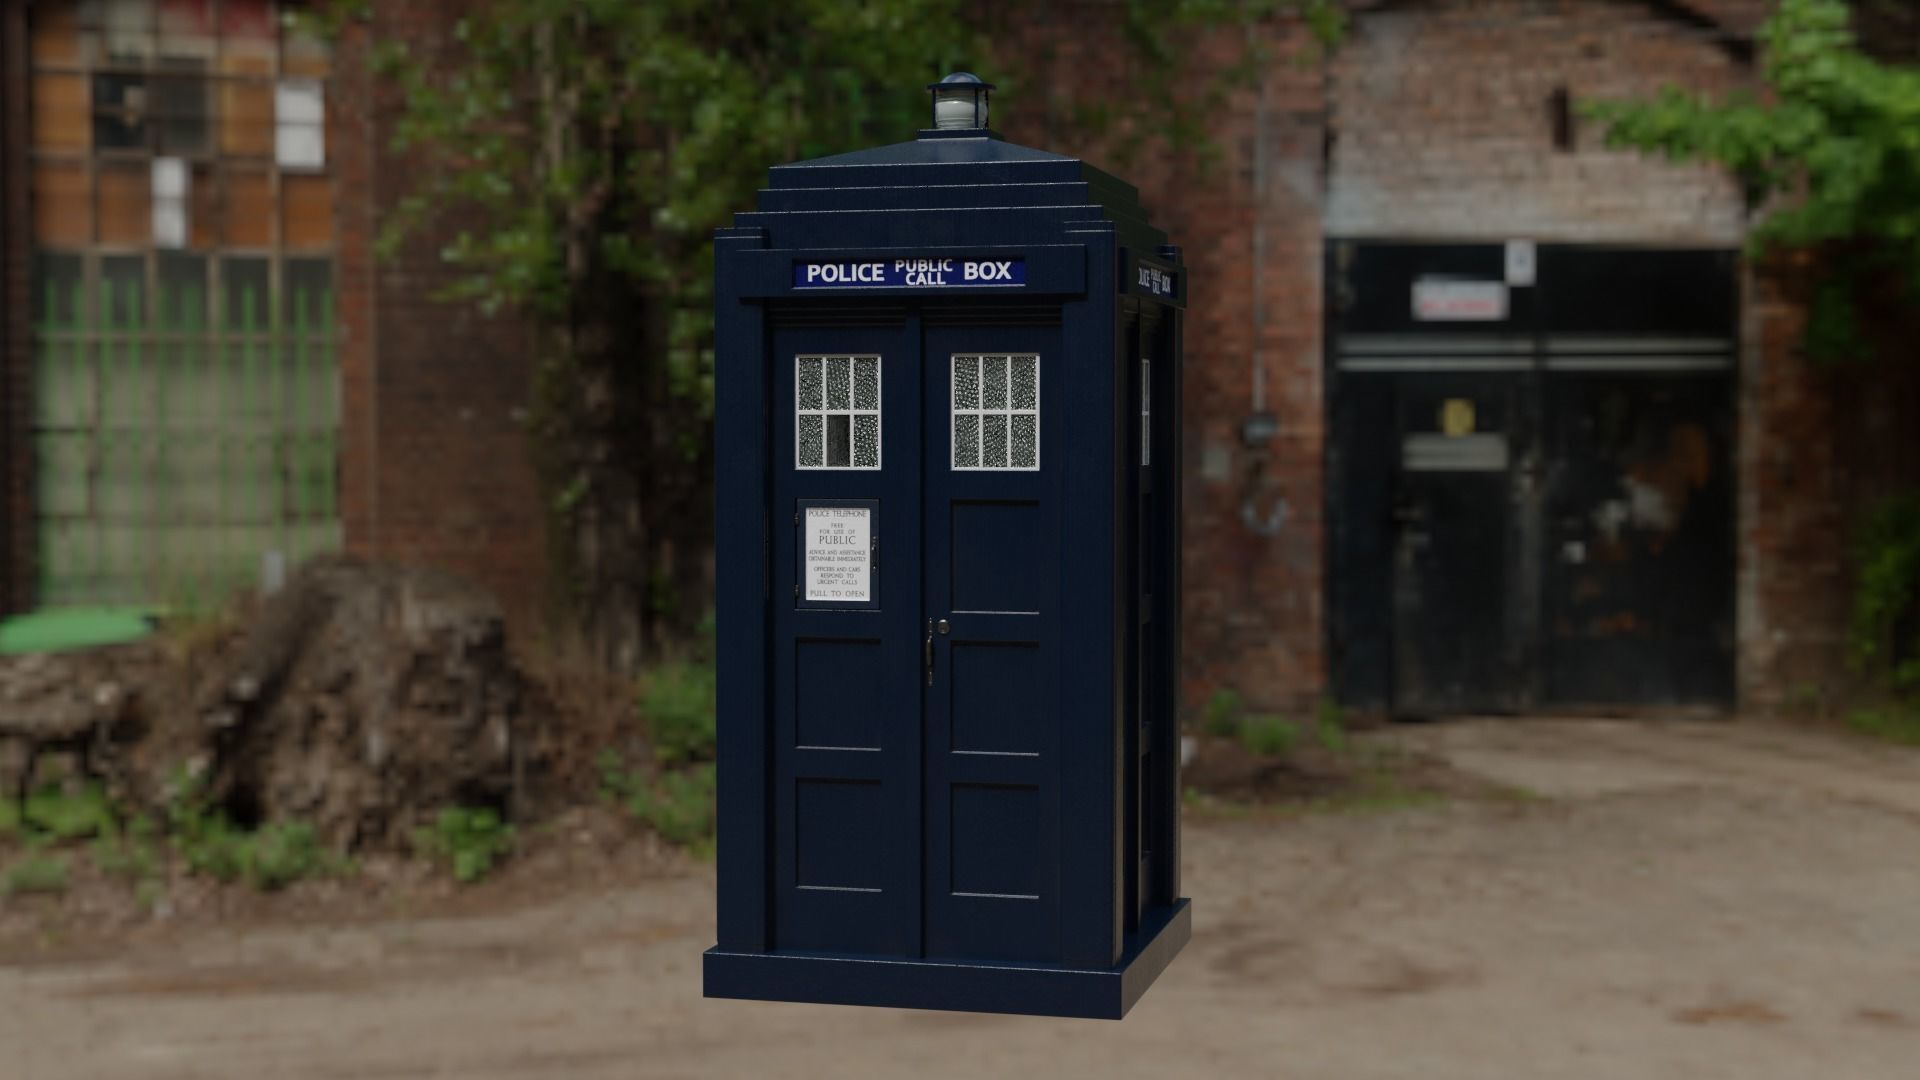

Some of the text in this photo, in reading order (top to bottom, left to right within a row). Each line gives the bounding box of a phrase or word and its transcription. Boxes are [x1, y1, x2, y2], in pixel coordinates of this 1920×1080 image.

[807, 261, 1012, 282] POLICE BOX
[895, 258, 953, 272] PUBLIC
[905, 272, 946, 286] CALL
[819, 536, 856, 544] PUBLIC
